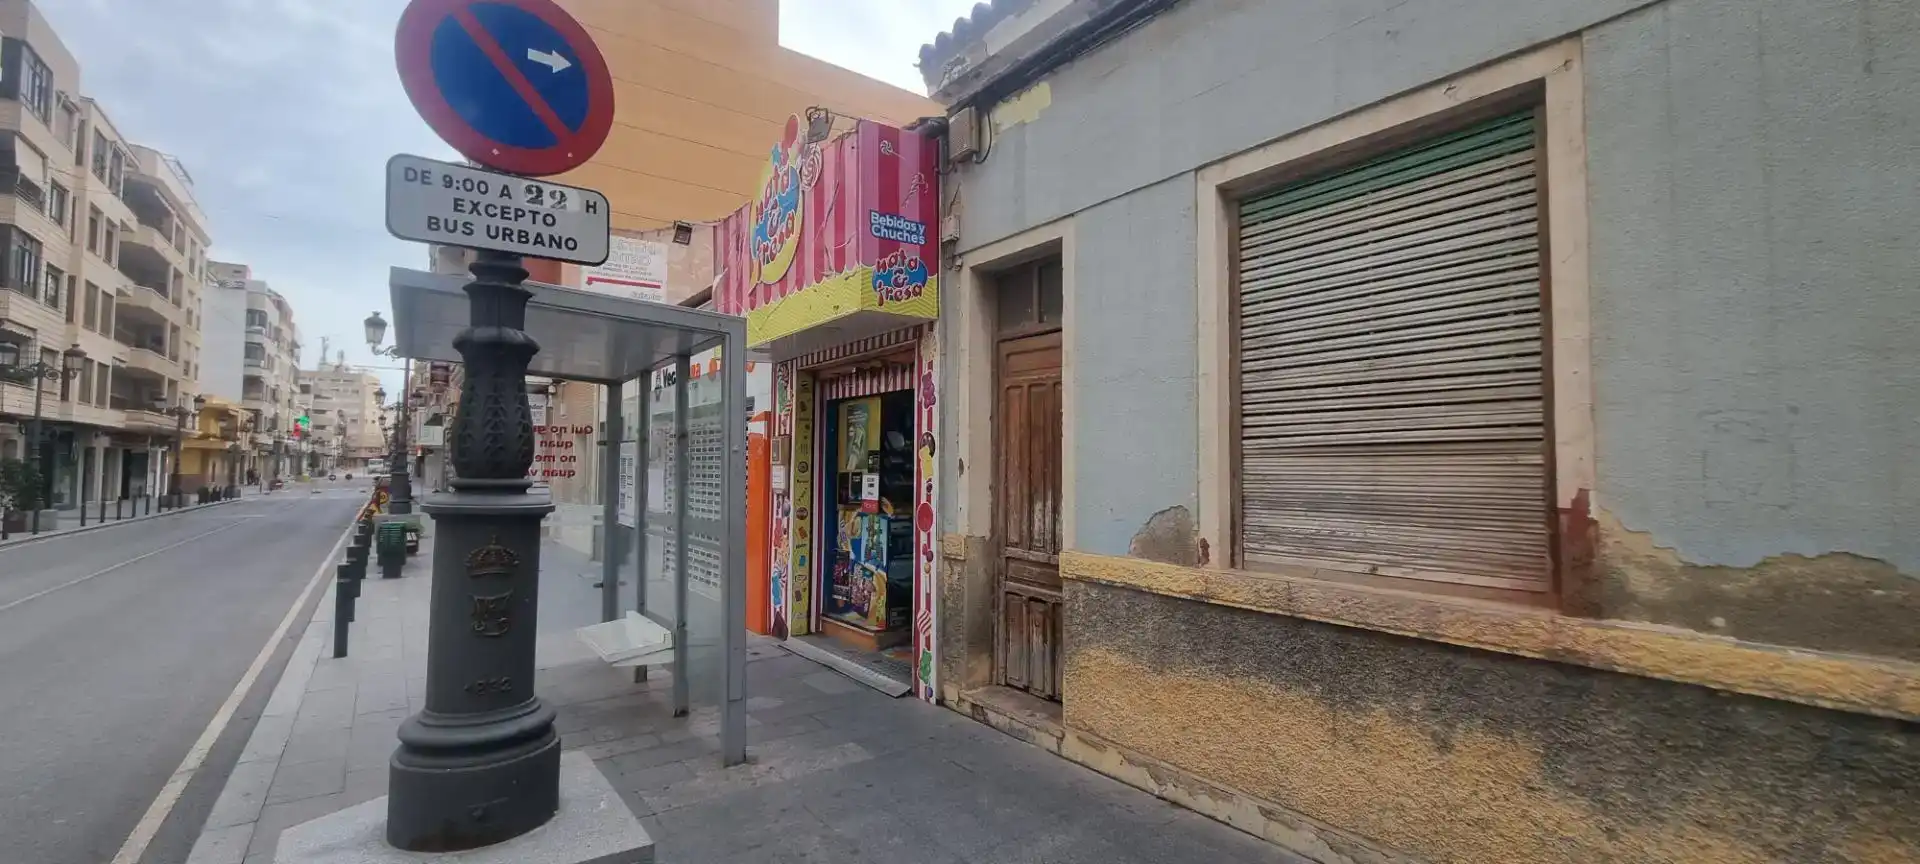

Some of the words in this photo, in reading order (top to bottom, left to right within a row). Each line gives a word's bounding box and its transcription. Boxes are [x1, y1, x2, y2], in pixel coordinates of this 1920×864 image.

[403, 166, 433, 186] DE
[442, 174, 489, 196] 9:00
[499, 184, 513, 200] A
[523, 184, 568, 211] 22
[585, 200, 598, 215] H
[452, 197, 557, 228] EXCEPTO
[871, 211, 917, 231] Bebidas
[426, 215, 475, 236] BUS
[486, 224, 578, 251] URBANO
[871, 224, 926, 245] Chuches
